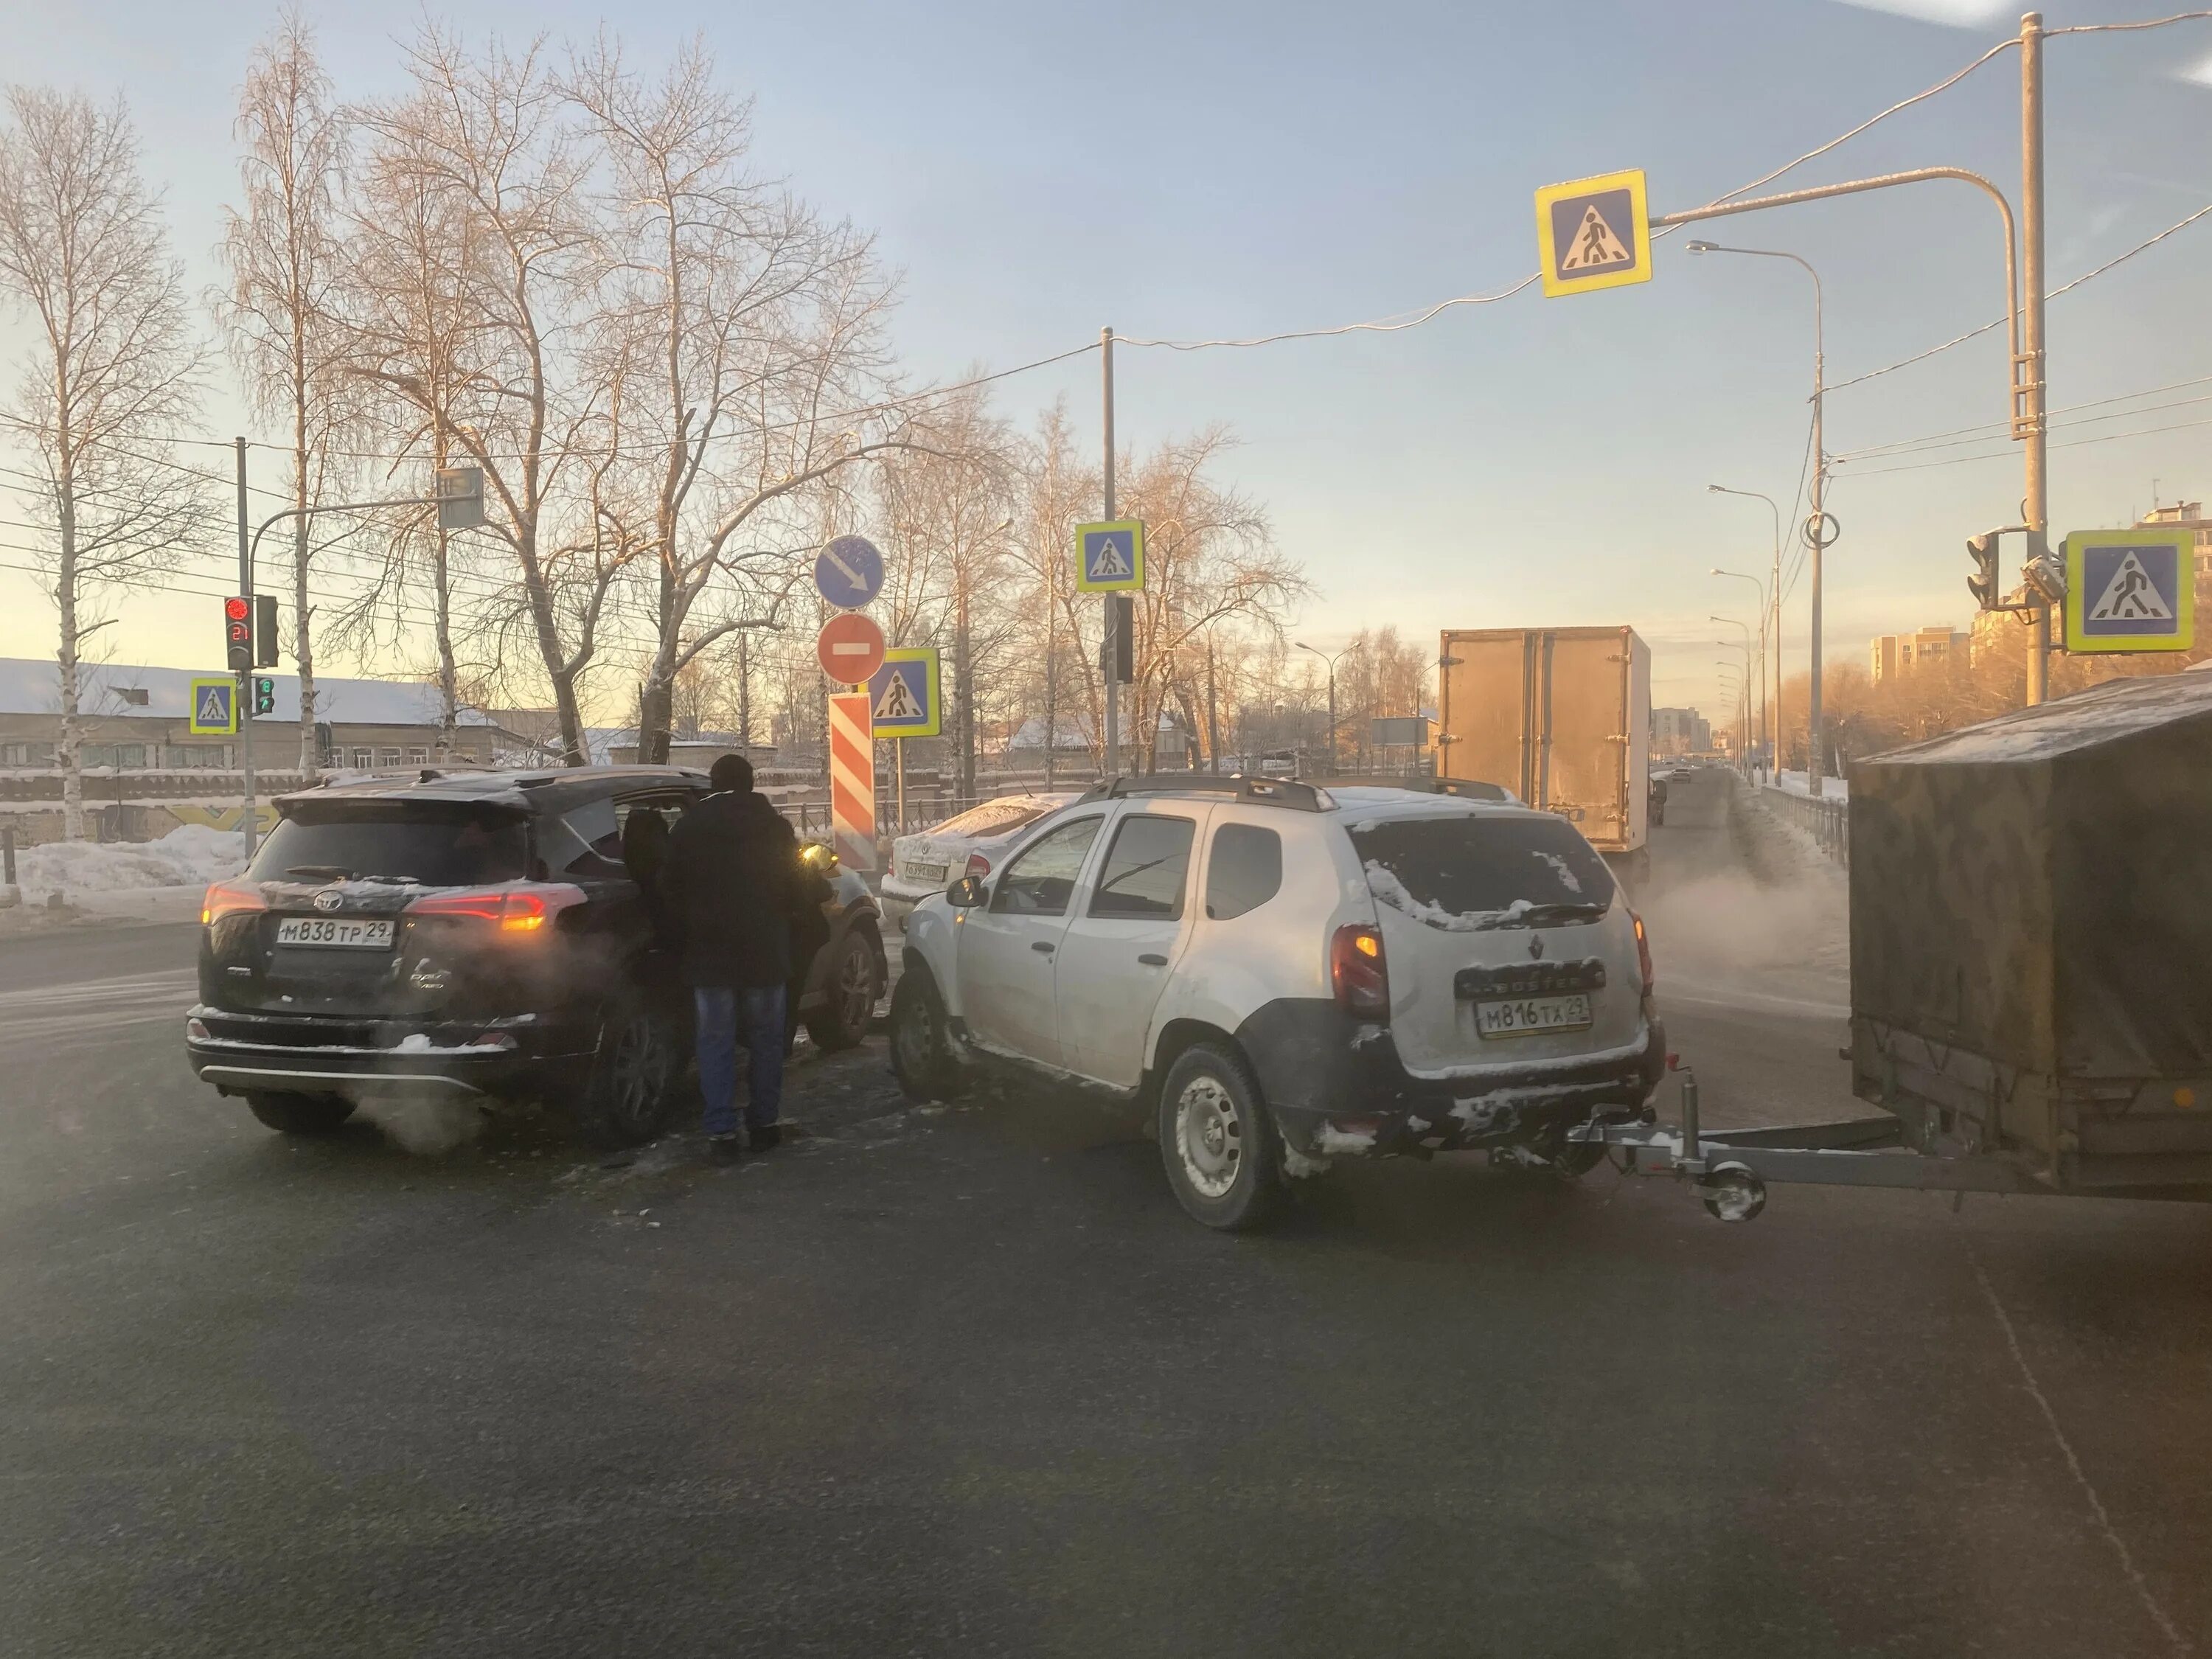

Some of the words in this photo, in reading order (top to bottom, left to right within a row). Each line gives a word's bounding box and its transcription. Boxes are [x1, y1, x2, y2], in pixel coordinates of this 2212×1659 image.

[232, 627, 248, 640] 21
[366, 922, 387, 937] 29
[1566, 997, 1583, 1015] 29
